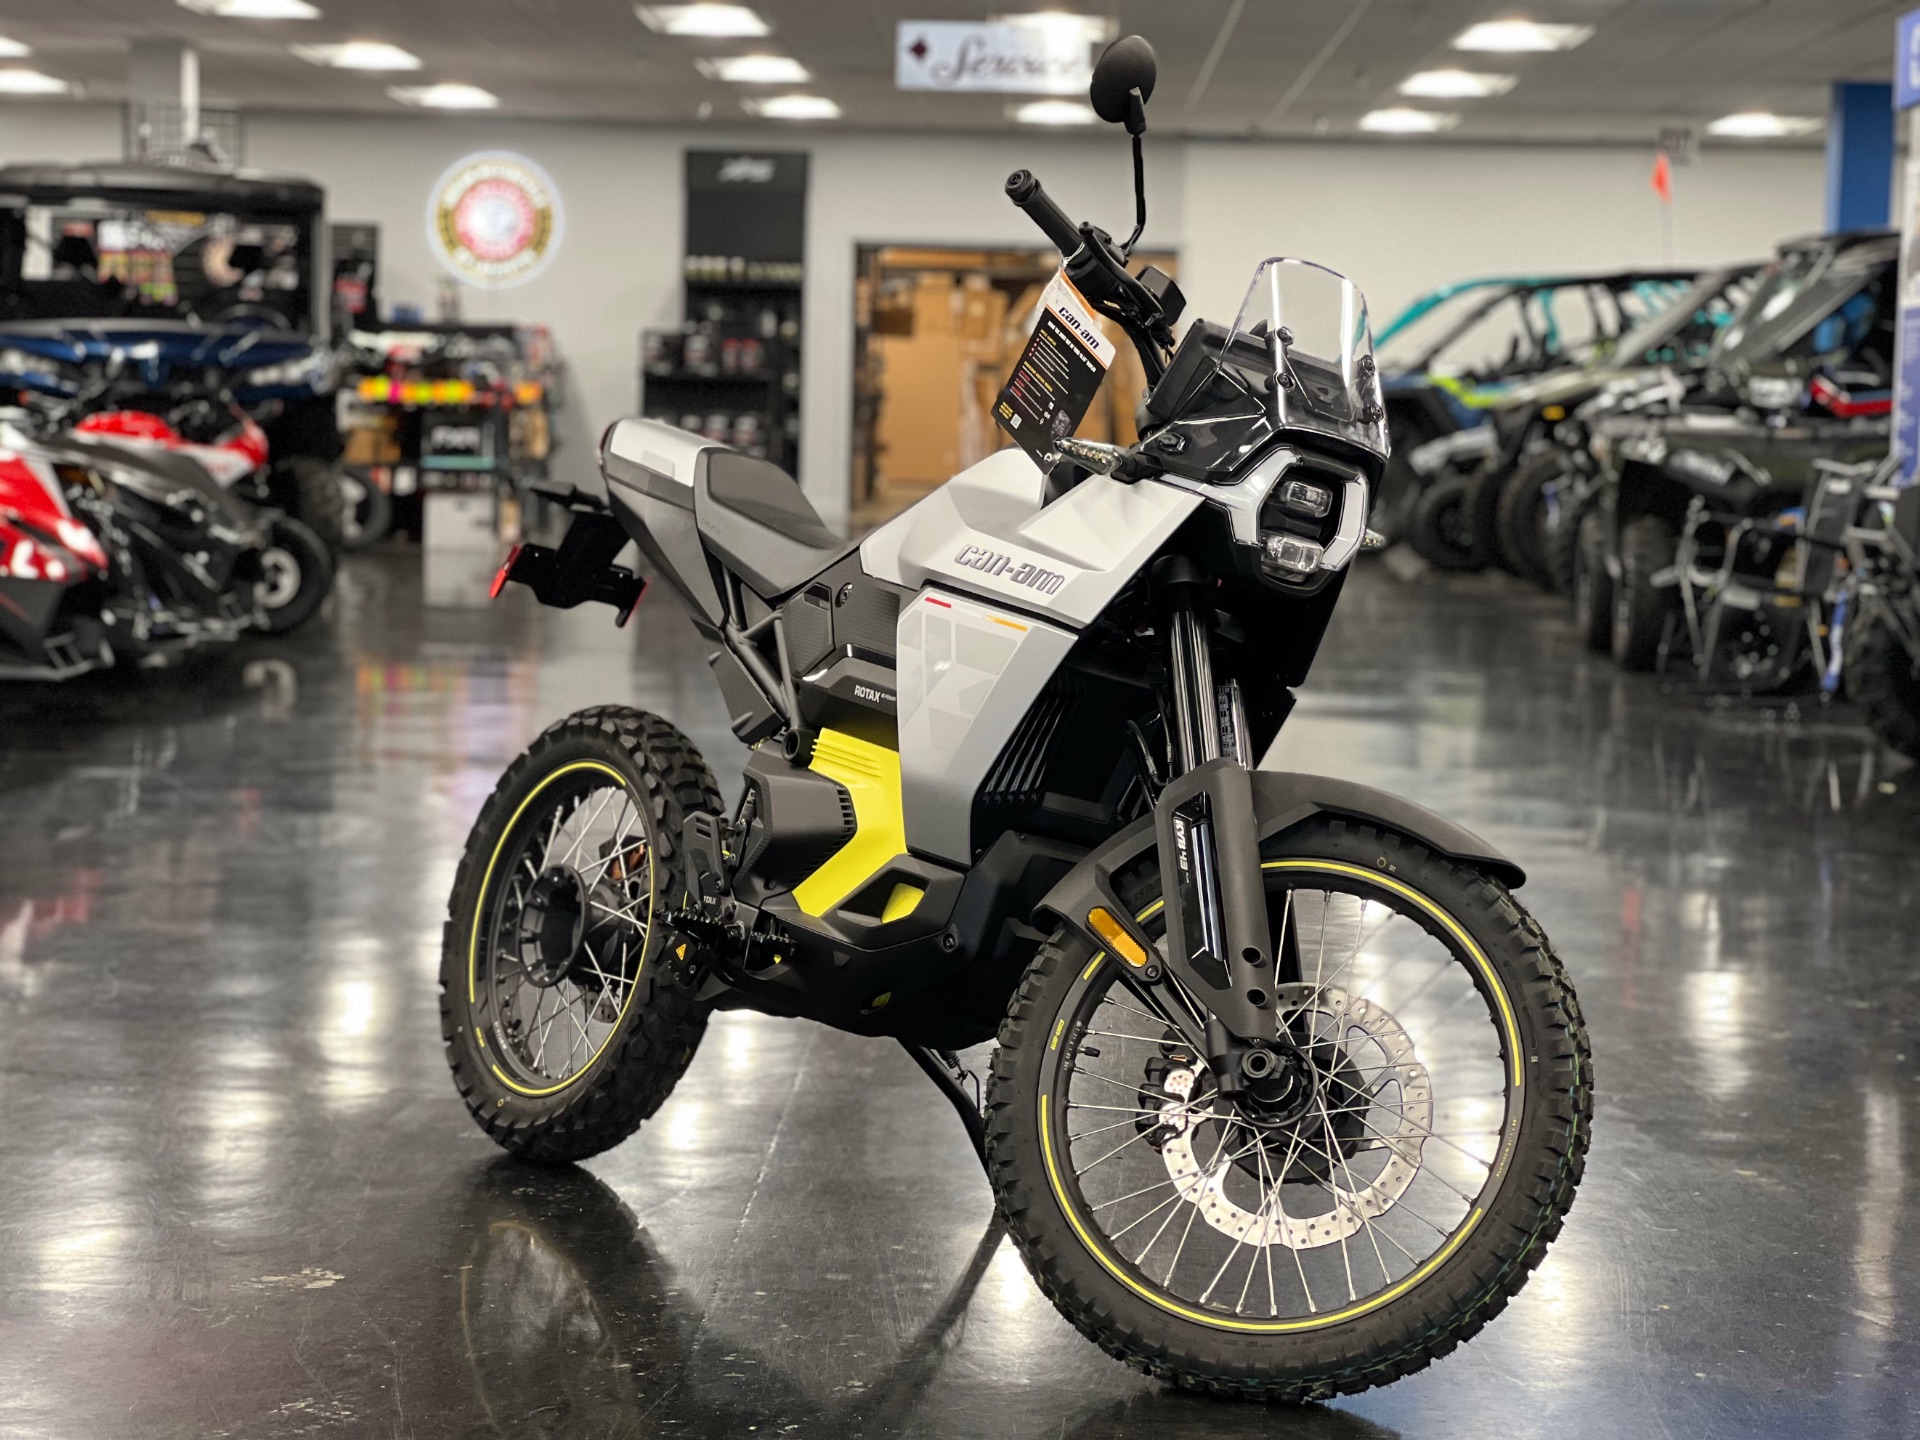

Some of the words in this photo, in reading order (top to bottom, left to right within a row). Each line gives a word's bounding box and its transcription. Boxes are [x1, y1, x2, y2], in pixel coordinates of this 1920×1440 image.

[1058, 306, 1100, 350] can-am
[953, 543, 1066, 596] can-am
[854, 684, 881, 703] ROTAX
[1175, 819, 1186, 850] KYB
[1179, 850, 1189, 871] 43
